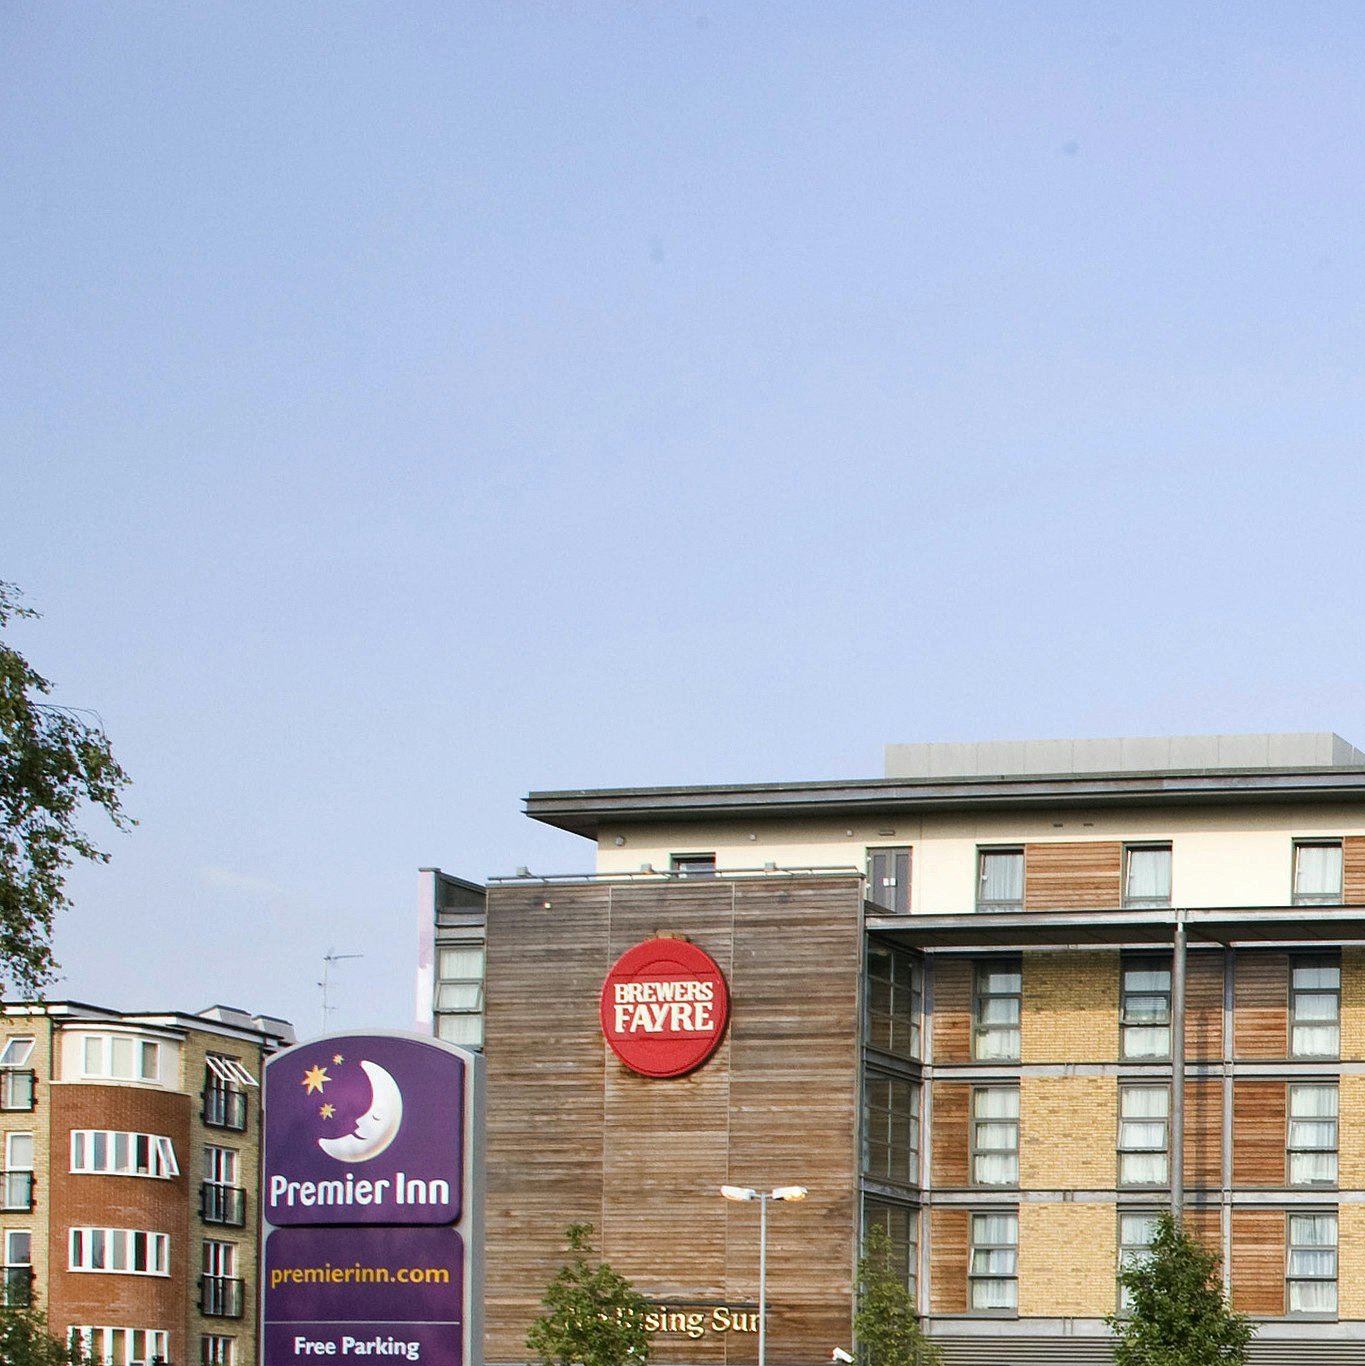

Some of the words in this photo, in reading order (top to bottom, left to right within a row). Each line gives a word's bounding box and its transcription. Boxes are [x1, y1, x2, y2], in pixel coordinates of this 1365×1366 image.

[613, 981, 714, 1004] BREWERS
[613, 1002, 714, 1033] FAYRE
[269, 1172, 391, 1207] Premier
[395, 1172, 450, 1205] Inn
[270, 1263, 450, 1289] premierinn.com
[293, 1336, 337, 1355] Free
[341, 1335, 421, 1361] Parking
